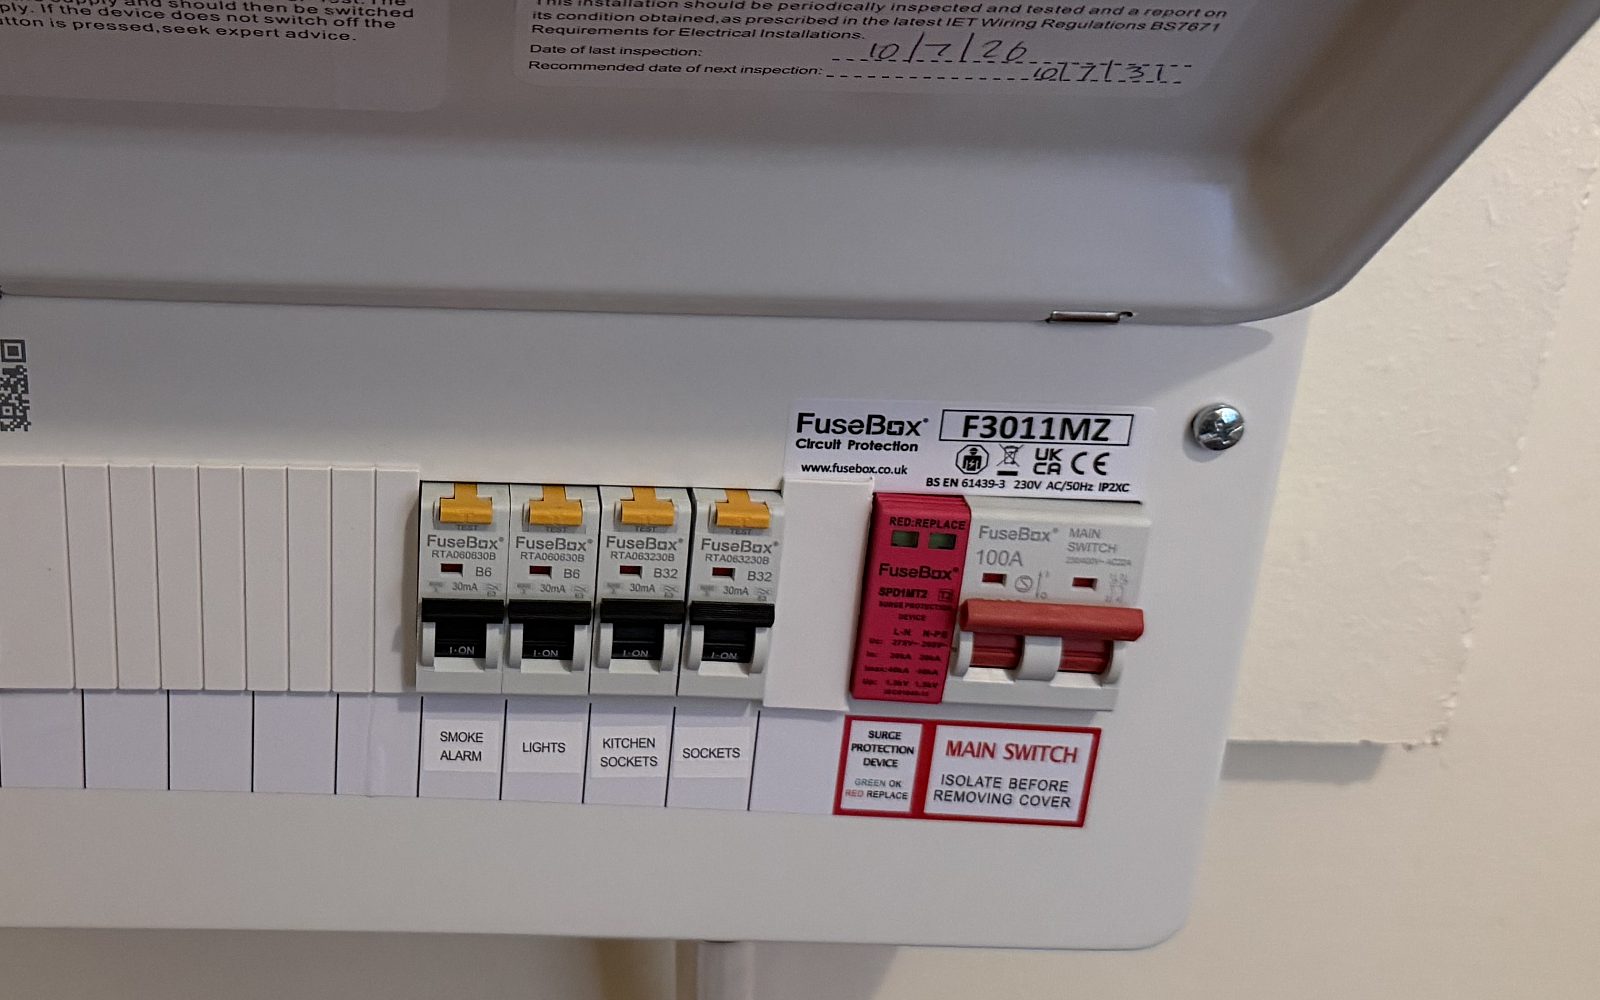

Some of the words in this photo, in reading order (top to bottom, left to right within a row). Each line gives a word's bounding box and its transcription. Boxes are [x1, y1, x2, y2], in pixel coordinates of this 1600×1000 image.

[168, 0, 237, 10] should
[243, 2, 288, 13] then
[294, 4, 318, 14] be
[325, 6, 414, 18] switched
[577, 0, 679, 8] installation
[684, 0, 745, 10] should
[751, 0, 773, 10] be
[777, 1, 885, 13] periodically
[890, 2, 982, 14] inspected
[986, 4, 1022, 14] and
[1027, 5, 1086, 15] tested
[1089, 6, 1125, 16] and
[1128, 8, 1140, 16] a
[1144, 8, 1201, 19] report
[1204, 10, 1228, 18] on
[41, 3, 54, 14] If
[60, 5, 92, 16] the
[99, 7, 165, 19] device
[171, 10, 221, 22] does
[227, 13, 259, 23] not
[264, 15, 328, 26] switch
[333, 17, 359, 28] off
[365, 18, 396, 29] the
[532, 11, 553, 20] its
[556, 11, 635, 21] condition
[745, 15, 838, 26] prescribed
[843, 15, 858, 25] in
[865, 16, 889, 26] the
[893, 17, 943, 27] latest
[946, 17, 978, 27] IET
[981, 18, 1037, 30] Wiring
[1041, 18, 1147, 31] Regulations
[1150, 21, 1221, 32] BS7671
[50, 18, 67, 28] is
[216, 27, 279, 39] expert
[285, 29, 357, 41] advice.
[532, 24, 649, 36] Requirements
[653, 26, 675, 37] for
[679, 27, 756, 38] Electrical
[761, 29, 866, 40] Installations.
[530, 44, 567, 54] Date
[570, 45, 587, 55] of
[589, 46, 616, 55] last
[620, 47, 703, 57] inspection:
[528, 60, 645, 73] Recommended
[649, 63, 682, 73] date
[686, 64, 702, 74] of
[704, 65, 737, 74] next
[741, 65, 824, 76] inspection:
[962, 414, 1112, 442] F3011MZ
[795, 438, 842, 451] Circuit
[848, 439, 919, 453] Protection
[801, 462, 908, 476] www.fusebox.co.uk
[926, 477, 940, 487] BS
[943, 478, 960, 488] EN
[961, 478, 1006, 490] 61439-3
[1013, 480, 1042, 490] 230V
[1045, 481, 1094, 492] AC/50Hz
[1098, 482, 1130, 493] IP2XC
[1069, 527, 1101, 539] MAIN
[1067, 541, 1118, 554] SWITCH
[976, 549, 1024, 567] 100A
[475, 566, 492, 577] B6
[563, 568, 580, 579] B6
[653, 567, 678, 579] B32
[747, 571, 773, 582] B32
[452, 581, 478, 592] 30mA
[540, 584, 566, 594] 30mA
[629, 583, 656, 593] 30mA
[723, 585, 749, 596] 30mA
[439, 730, 484, 743] SMOKE
[867, 730, 902, 741] SURGE
[522, 742, 567, 753] LIGHTS
[602, 736, 656, 749] KITCHEN
[851, 743, 915, 755] PROTECTION
[439, 750, 483, 762] ALARM
[682, 747, 741, 760] SOCKETS
[945, 739, 997, 759] MAIN
[1003, 742, 1079, 764] SWITCH
[600, 755, 658, 768] SOCKETS
[863, 757, 899, 768] DEVICE
[854, 777, 886, 788] GREEN
[888, 779, 902, 788] OK
[940, 774, 1002, 789] ISOLATE
[1008, 777, 1069, 792] BEFORE
[845, 789, 864, 798] RED
[866, 790, 909, 800] REPLACE
[933, 789, 1013, 806] REMOVING
[1019, 792, 1071, 808] COVER
